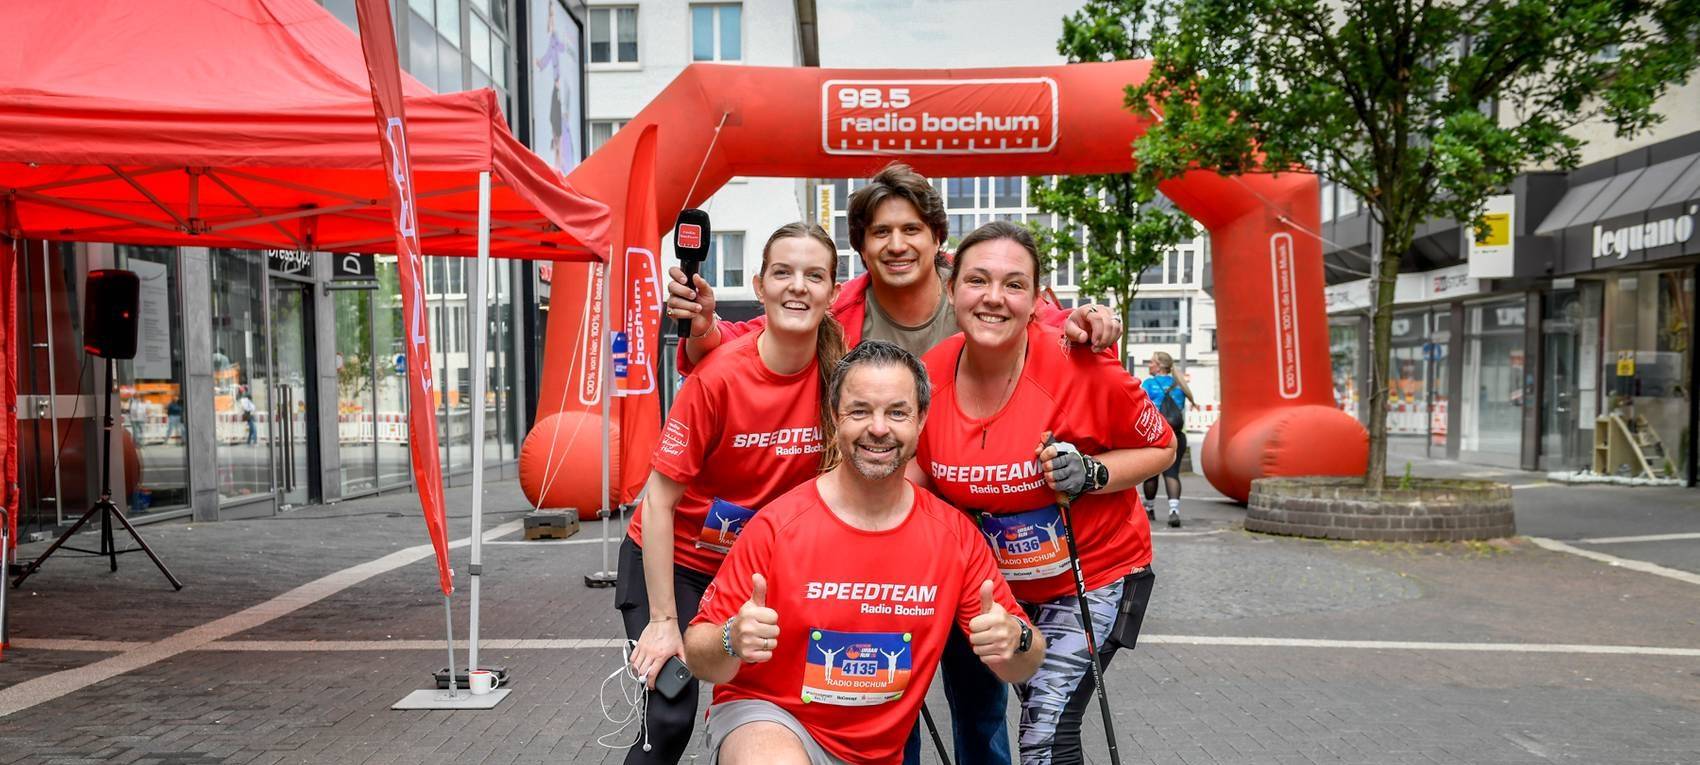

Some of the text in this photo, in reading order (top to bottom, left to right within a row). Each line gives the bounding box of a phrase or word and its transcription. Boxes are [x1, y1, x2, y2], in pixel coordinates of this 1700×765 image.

[838, 88, 911, 109] 98.5
[840, 112, 1040, 132] radio bochum
[1592, 214, 1694, 259] leguano
[594, 278, 603, 300] beste
[593, 301, 602, 313] die
[591, 313, 600, 337] 100%
[634, 279, 645, 365] bochum
[587, 372, 596, 395] 100%
[775, 443, 824, 456] Radio Boch
[930, 460, 1043, 482] SPEEDTEAM
[969, 484, 1000, 494] Radio
[1007, 539, 1040, 554] 4136
[1023, 552, 1056, 564] BOCHUM
[1075, 558, 1087, 597] LEKI
[805, 582, 938, 602] SPEEDTEAM
[860, 603, 935, 616] Radio Bochum
[842, 662, 876, 675] 4135
[826, 679, 887, 688] RADIO BOCHUM
